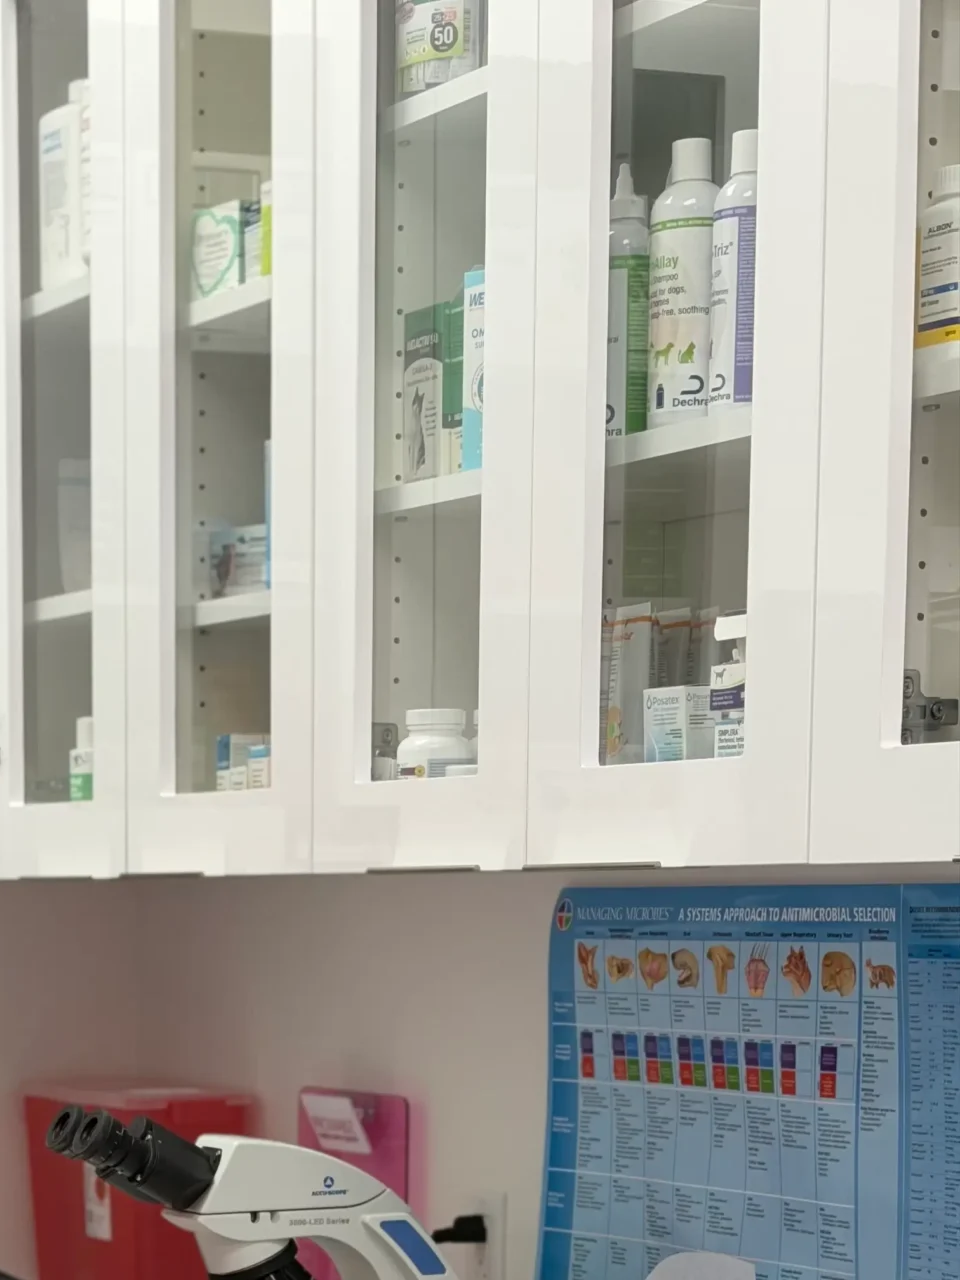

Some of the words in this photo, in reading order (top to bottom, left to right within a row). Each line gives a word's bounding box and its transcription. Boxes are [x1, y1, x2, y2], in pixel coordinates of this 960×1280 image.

[434, 26, 454, 46] 50
[677, 306, 710, 316] soothing
[576, 907, 623, 921] MANAGING
[678, 908, 685, 921] A
[686, 908, 722, 921] SYSTEMS
[723, 907, 767, 922] APPROACH
[769, 908, 779, 921] TO
[781, 907, 851, 922] ANTIMICROBIAL
[854, 907, 896, 922] SELECTION
[326, 1216, 350, 1225] Series
